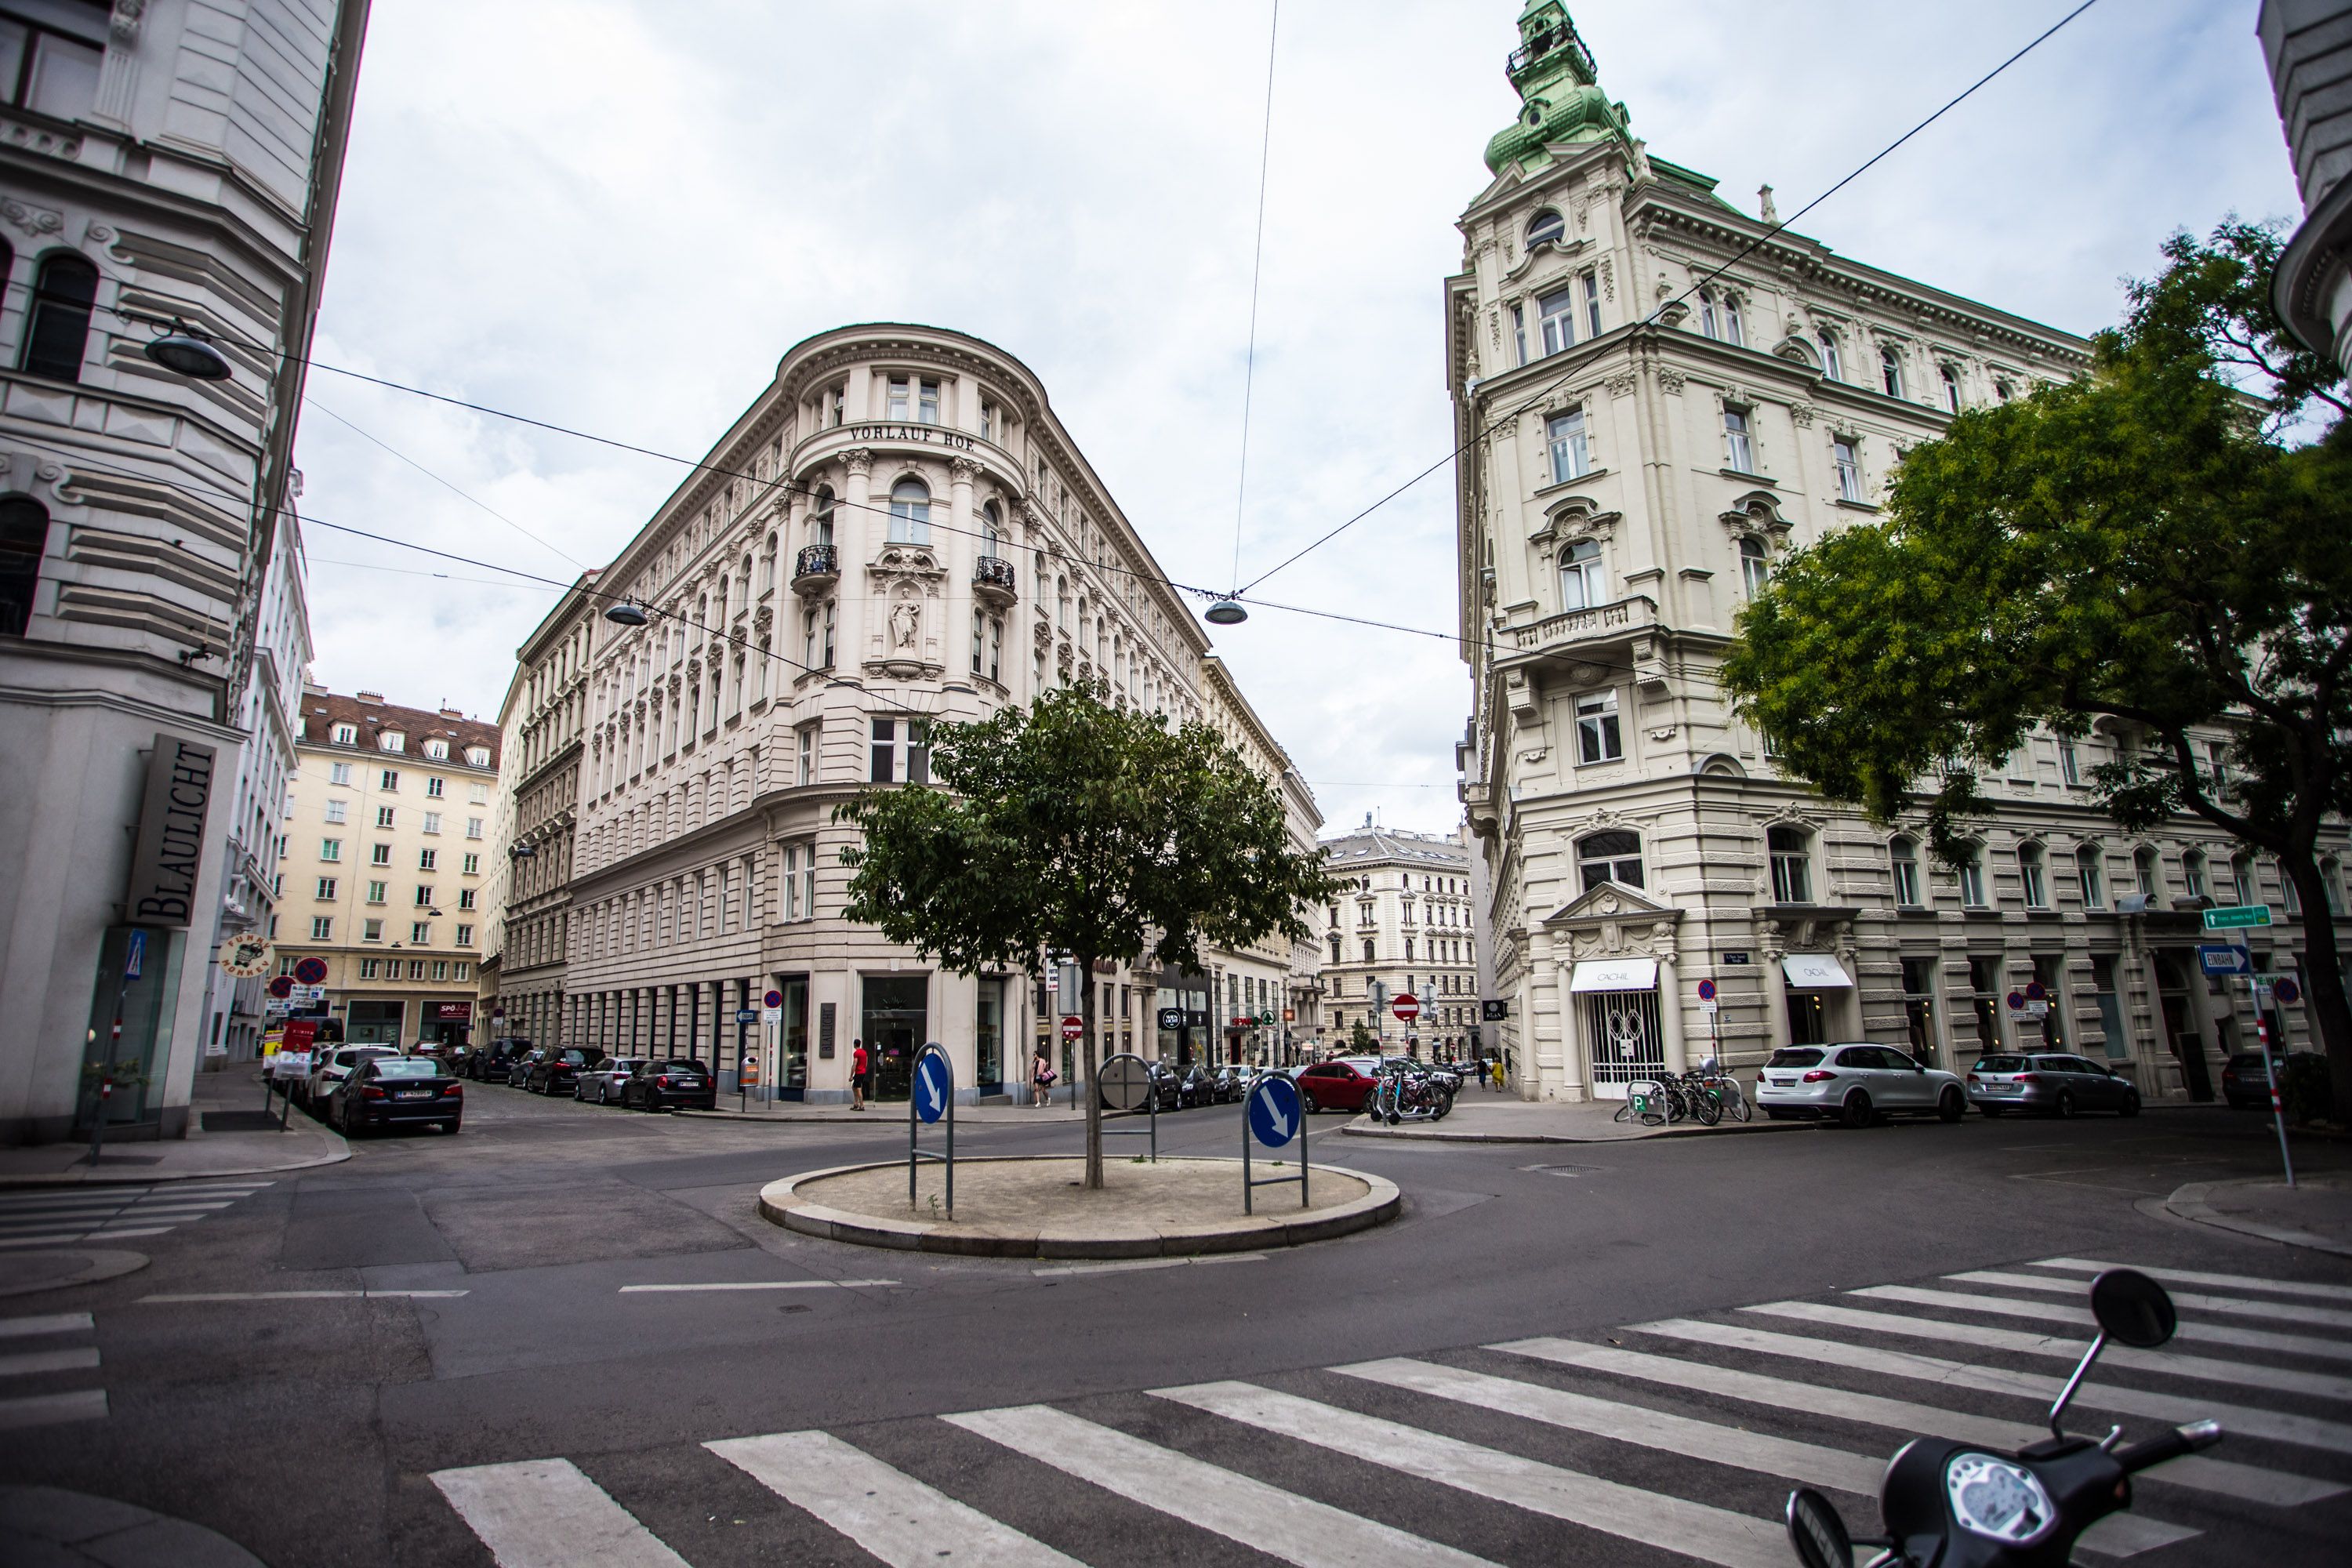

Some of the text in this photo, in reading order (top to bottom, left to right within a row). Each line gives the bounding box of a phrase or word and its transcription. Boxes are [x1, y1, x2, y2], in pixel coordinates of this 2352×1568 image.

[850, 425, 933, 441] VORLAUF
[136, 742, 212, 922] BLAULICHT
[227, 935, 270, 949] FUNKY
[2206, 953, 2234, 966] EINBAHN
[222, 960, 269, 976] MONKEY
[821, 1008, 833, 1051] BLAULICHT
[1634, 1096, 1643, 1110] P
